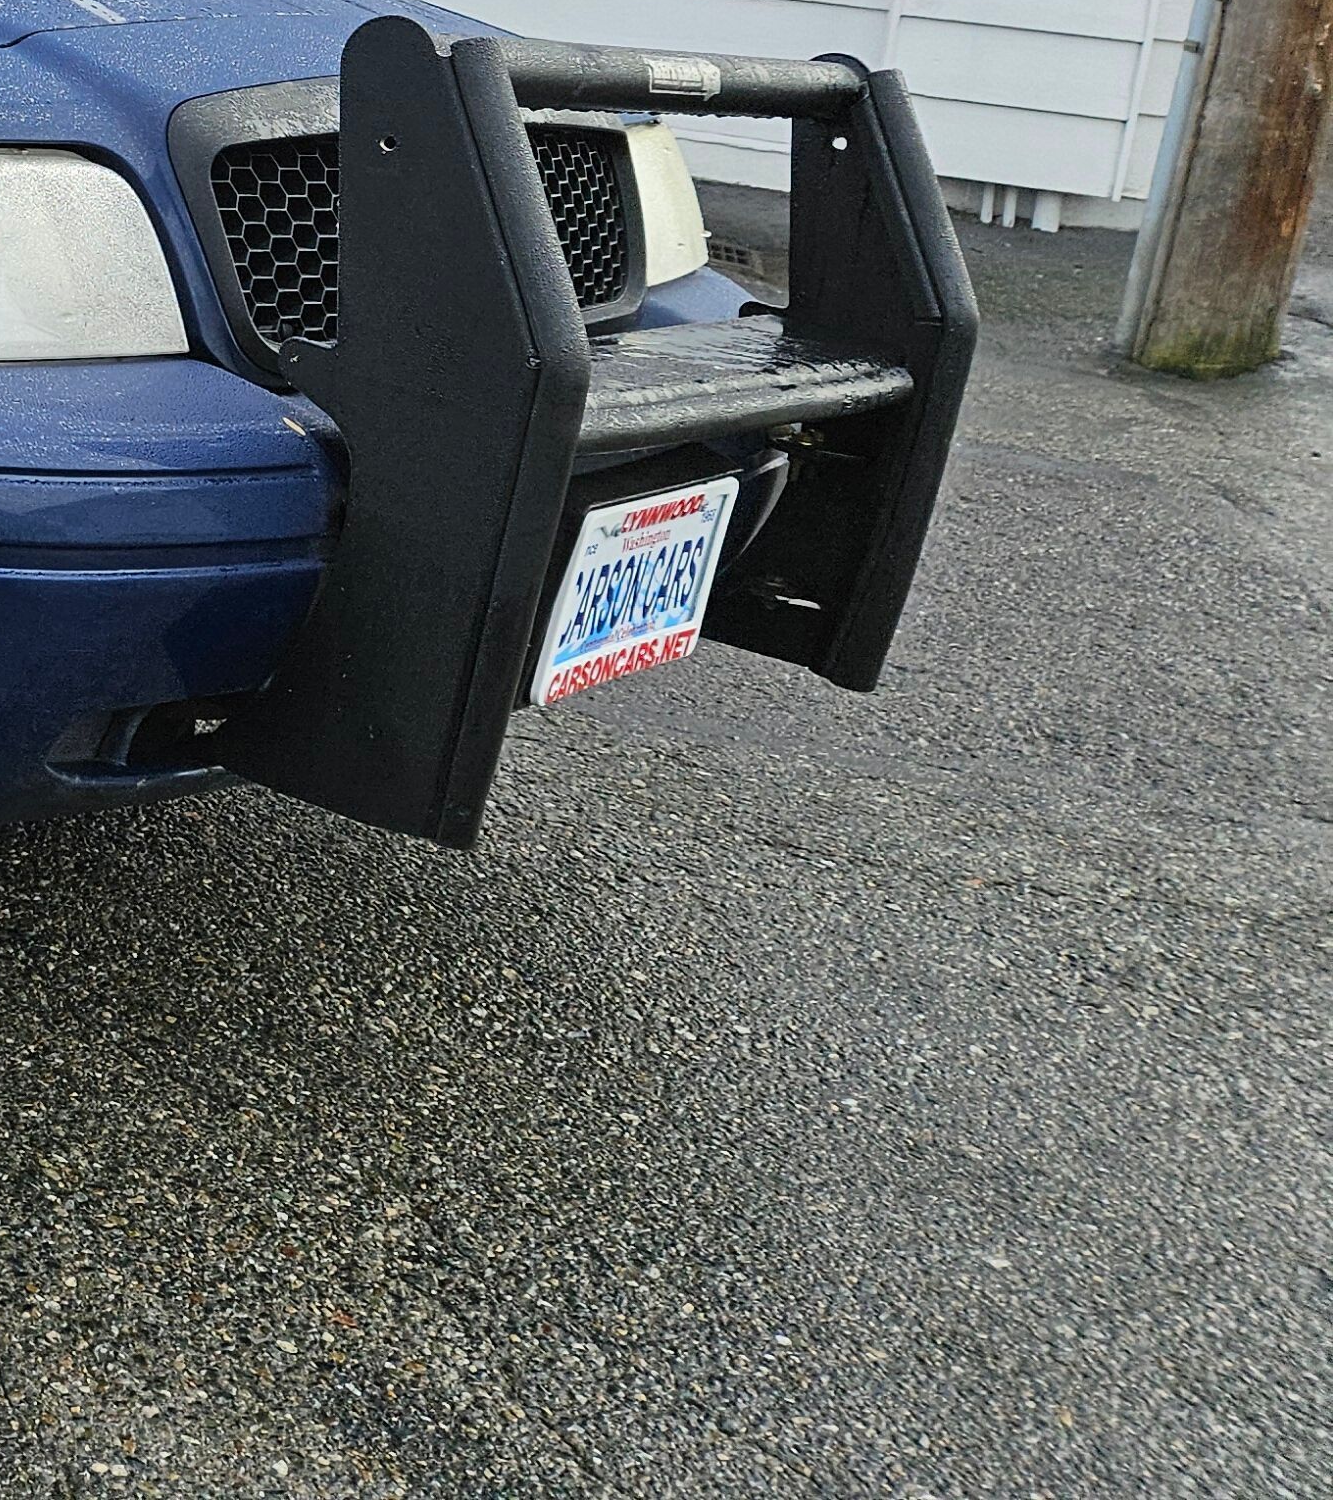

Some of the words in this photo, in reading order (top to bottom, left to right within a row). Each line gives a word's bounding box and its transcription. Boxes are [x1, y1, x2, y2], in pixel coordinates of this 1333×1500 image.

[620, 494, 705, 533] LYNNWOOD
[622, 529, 671, 554] Washington
[545, 628, 698, 704] CARSONCARS.NET
